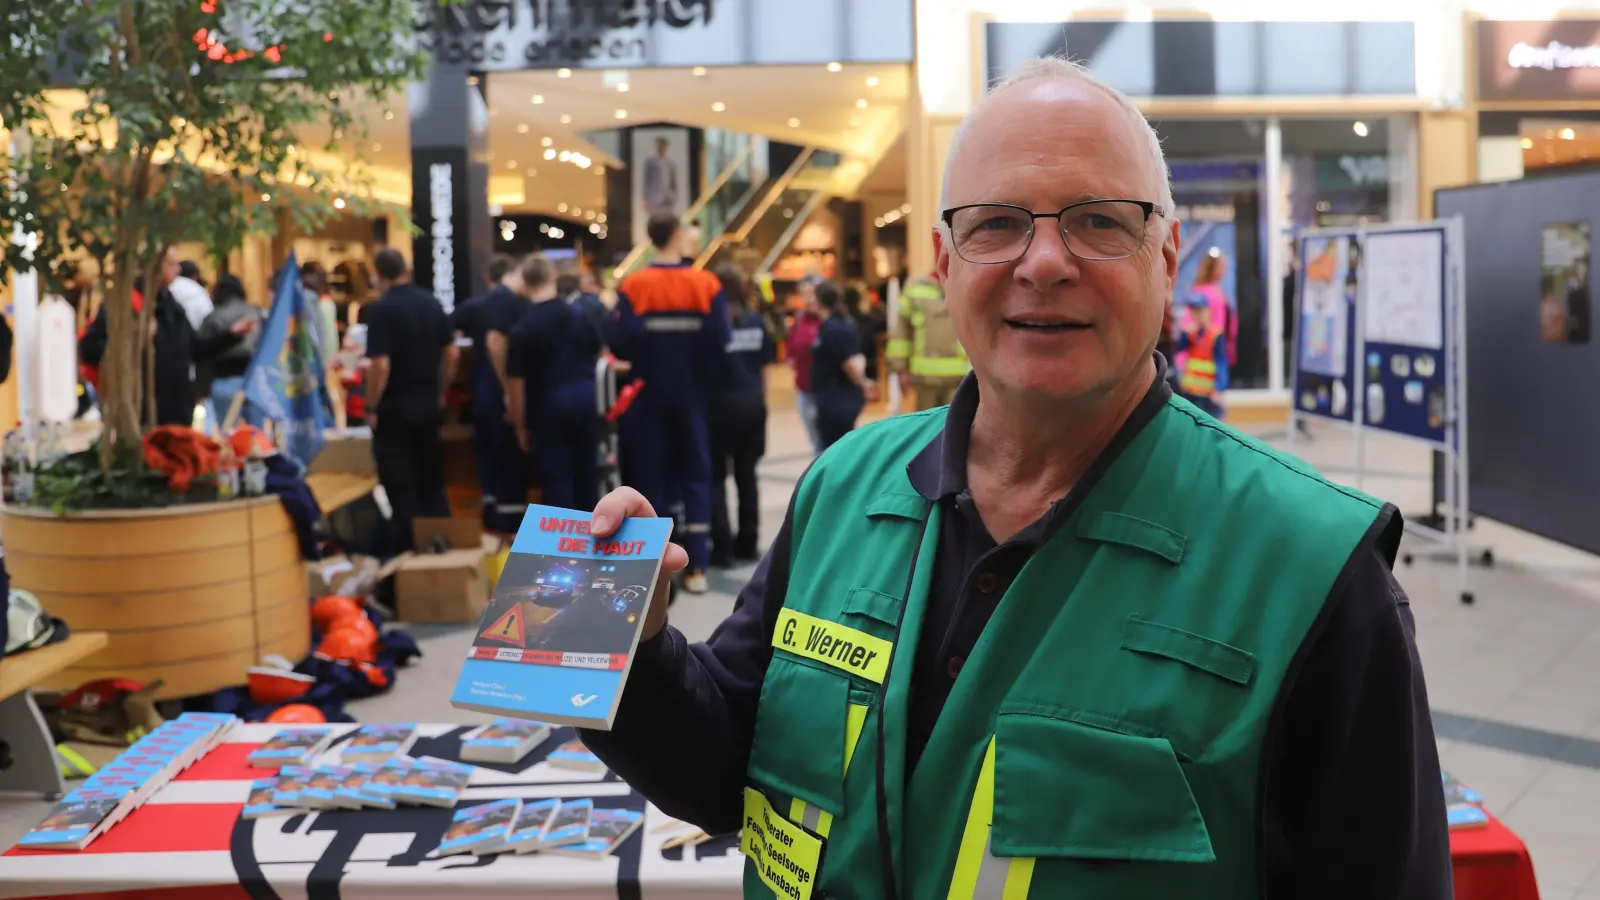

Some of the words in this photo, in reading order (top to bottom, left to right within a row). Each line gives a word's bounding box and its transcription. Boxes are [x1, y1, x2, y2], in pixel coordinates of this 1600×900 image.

[540, 517, 592, 535] UNTE
[556, 537, 589, 553] DIE
[592, 539, 646, 556] HAUT
[574, 656, 587, 664] UND
[782, 617, 797, 648] G.
[805, 624, 877, 671] Werner
[762, 807, 795, 848] Ferater
[746, 816, 811, 883] Feur-Seelsorge
[765, 864, 802, 900] Ansbach
